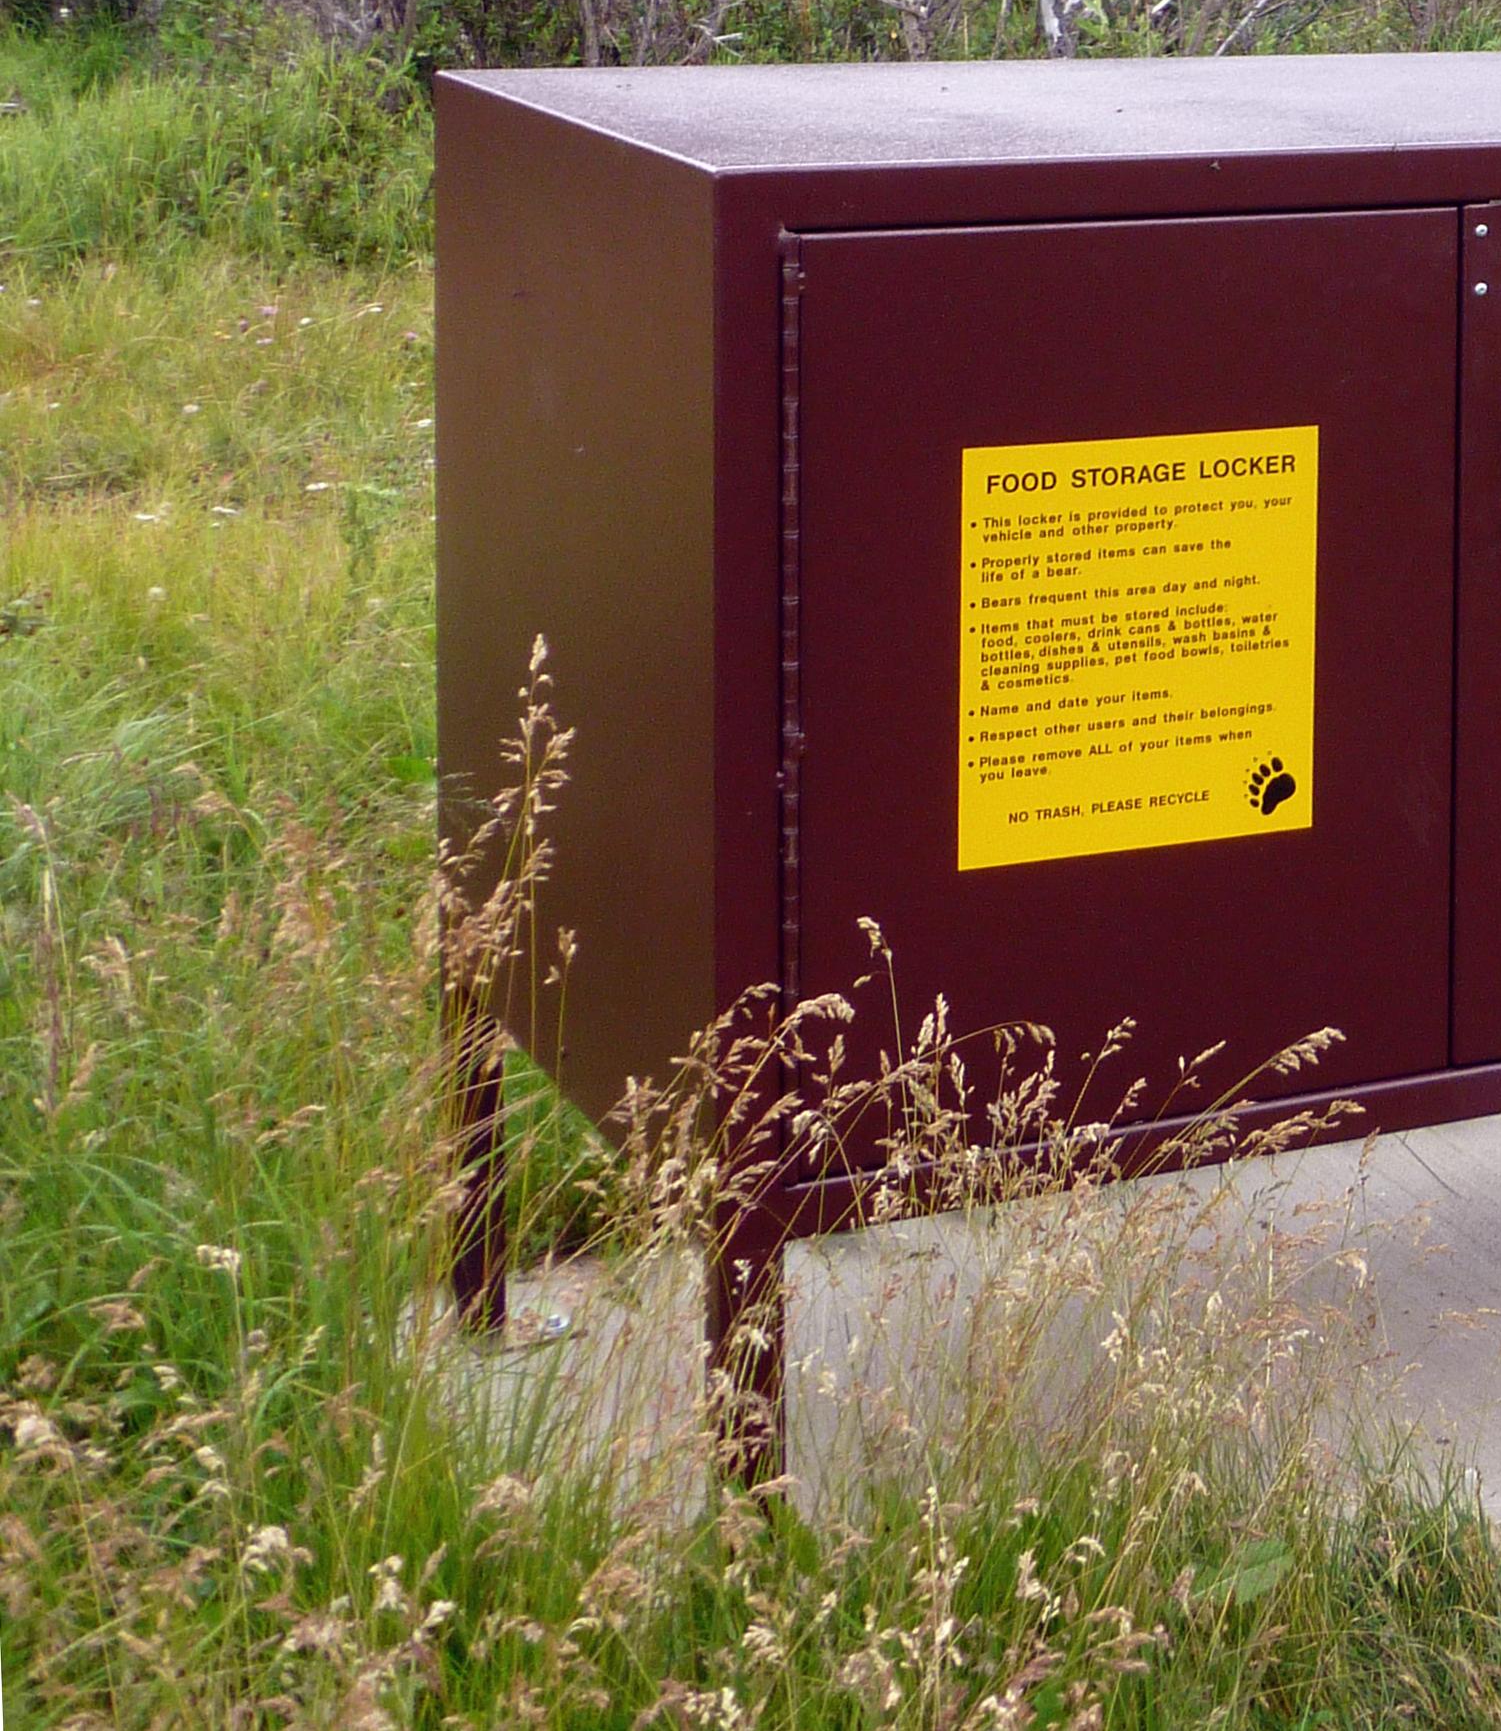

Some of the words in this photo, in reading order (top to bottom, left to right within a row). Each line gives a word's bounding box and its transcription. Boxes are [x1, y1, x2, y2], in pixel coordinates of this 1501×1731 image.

[987, 471, 1057, 494] FOOD
[1072, 462, 1186, 488] STORAGE
[1200, 455, 1295, 479] LOCKER
[984, 518, 1011, 528] This
[1019, 512, 1062, 526] locker
[1069, 511, 1080, 522] is
[1088, 506, 1147, 522] provided
[1154, 505, 1167, 515] to
[1175, 501, 1223, 516] protect
[1231, 499, 1257, 512] you,
[1264, 497, 1292, 509] your
[983, 529, 1032, 543] vehicle
[1039, 526, 1064, 538] and
[1072, 523, 1109, 536] other
[982, 554, 1039, 569] Properly
[1047, 550, 1091, 563] stored
[1098, 547, 1135, 559] items
[1143, 545, 1166, 555] can
[1174, 542, 1203, 552] save
[1211, 539, 1231, 549] the
[982, 571, 1003, 583] life
[1011, 569, 1025, 580] of
[1032, 570, 1039, 578] a
[1047, 566, 1082, 578] bear.
[982, 596, 1021, 609] Bears
[1029, 590, 1087, 604] frequent
[1095, 587, 1119, 598] this
[1127, 584, 1156, 596] area
[1163, 582, 1186, 593] day
[1194, 578, 1217, 590] and
[1224, 575, 1260, 588] night.
[981, 623, 1019, 634] Items
[1027, 619, 1054, 630] that
[1061, 614, 1094, 627] must
[1102, 612, 1118, 623] be
[1125, 608, 1169, 620] stored
[982, 636, 1018, 648] food,
[1025, 630, 1080, 644] coolers,
[1088, 626, 1121, 638] drink
[1129, 623, 1160, 634] cans
[1168, 621, 1176, 631] &
[1184, 616, 1236, 630] bottles,
[1242, 613, 1278, 624] water
[981, 648, 1034, 663] bottles,
[1039, 644, 1084, 657] dishes
[1091, 641, 1100, 652] &
[1108, 637, 1166, 650] utensils,
[1173, 632, 1206, 645] wash
[1213, 627, 1255, 640] basins
[1263, 625, 1271, 636] &
[981, 662, 1039, 676] cleaning
[1047, 656, 1109, 670] supplies,
[1115, 653, 1137, 665] pet
[1144, 649, 1175, 661] food
[1182, 644, 1224, 658] bowls,
[1231, 638, 1289, 652] toiletries
[981, 680, 989, 690] &
[980, 704, 1019, 716] Name
[1026, 700, 1050, 711] and
[1059, 697, 1088, 709] date
[1096, 693, 1125, 707] your
[1132, 689, 1172, 702] items.
[980, 727, 1037, 742] Respect
[1045, 724, 1080, 736] other
[1088, 717, 1125, 730] users
[1132, 714, 1156, 726] and
[1164, 710, 1193, 723] their
[980, 754, 1025, 767] Please
[1033, 747, 1082, 761] remove
[1089, 743, 1112, 755] ALL
[1119, 741, 1132, 752] of
[1140, 739, 1169, 752] your
[1176, 734, 1212, 746] items
[1219, 730, 1252, 741] when
[980, 771, 1004, 783] you
[1009, 811, 1028, 823] NO
[1036, 805, 1084, 820] TRASH,
[1092, 798, 1142, 814] PLEASE
[1150, 790, 1209, 807] RECYCLE
